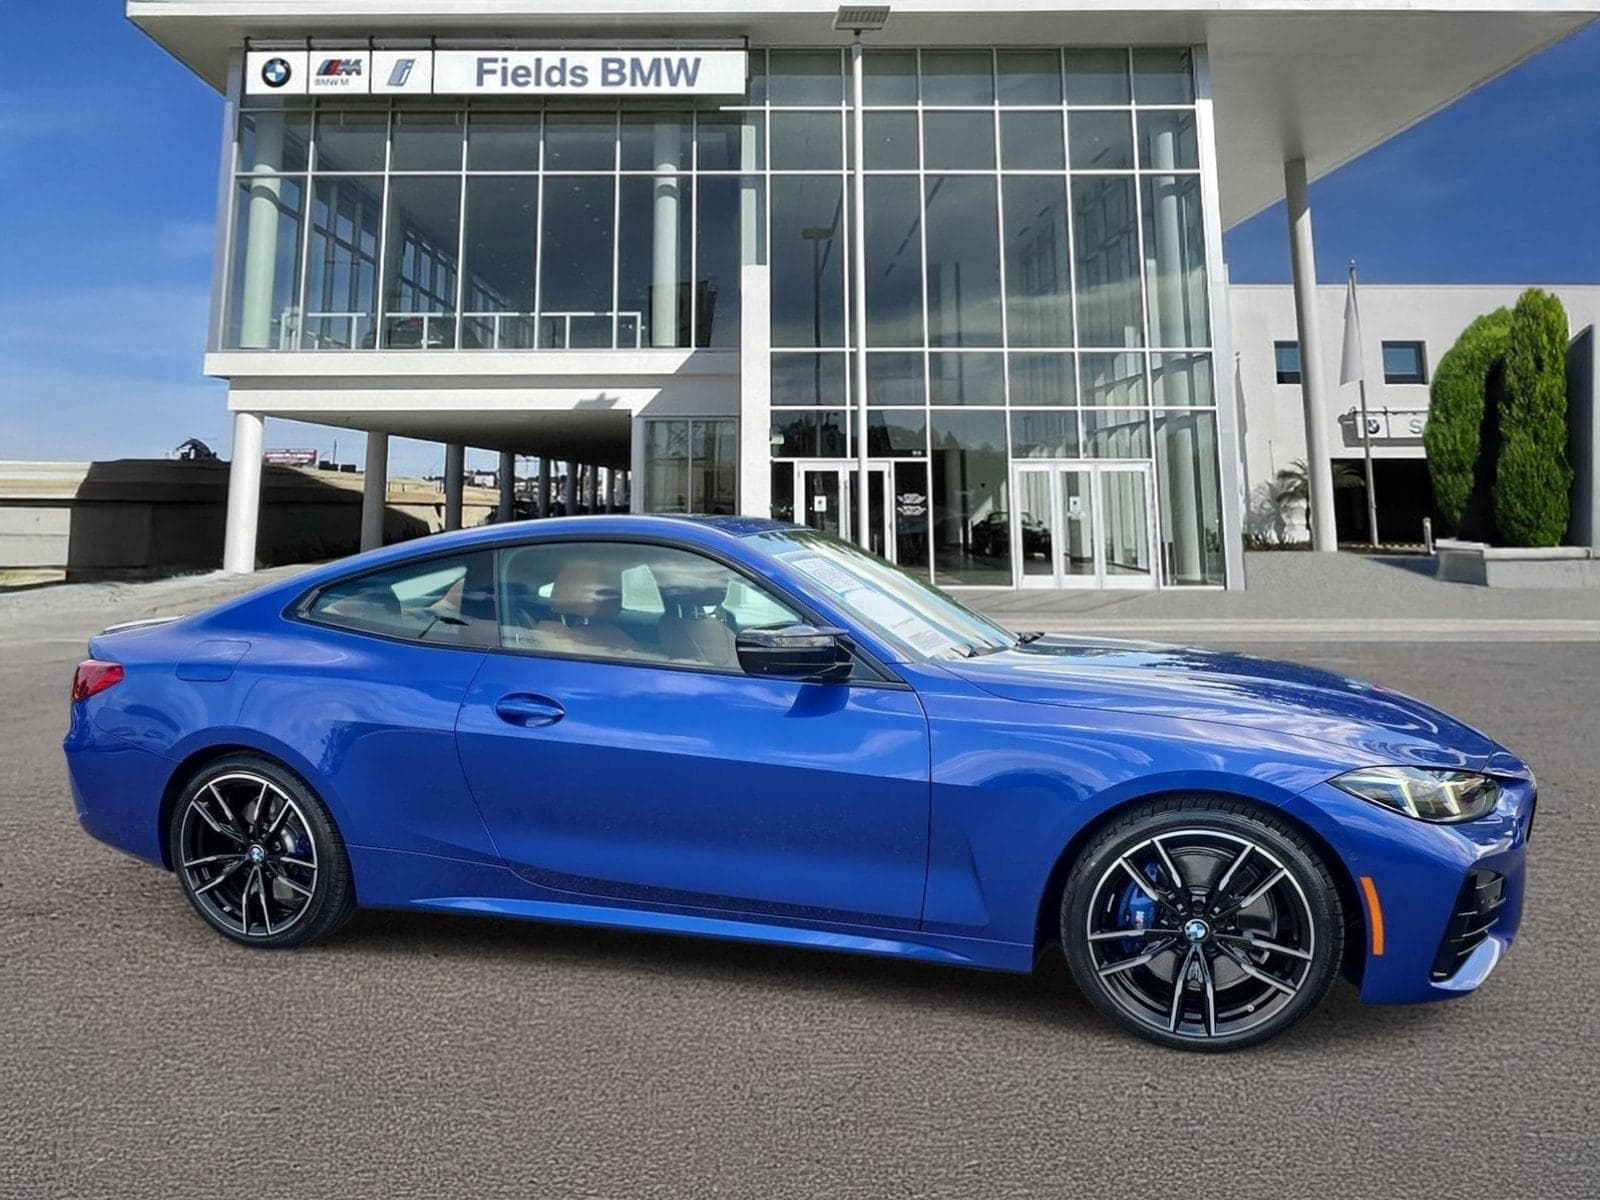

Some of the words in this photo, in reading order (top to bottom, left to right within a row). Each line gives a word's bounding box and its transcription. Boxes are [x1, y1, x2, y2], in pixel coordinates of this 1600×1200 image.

[314, 78, 338, 86] BMW
[476, 57, 589, 88] Fields
[601, 57, 702, 88] BMW
